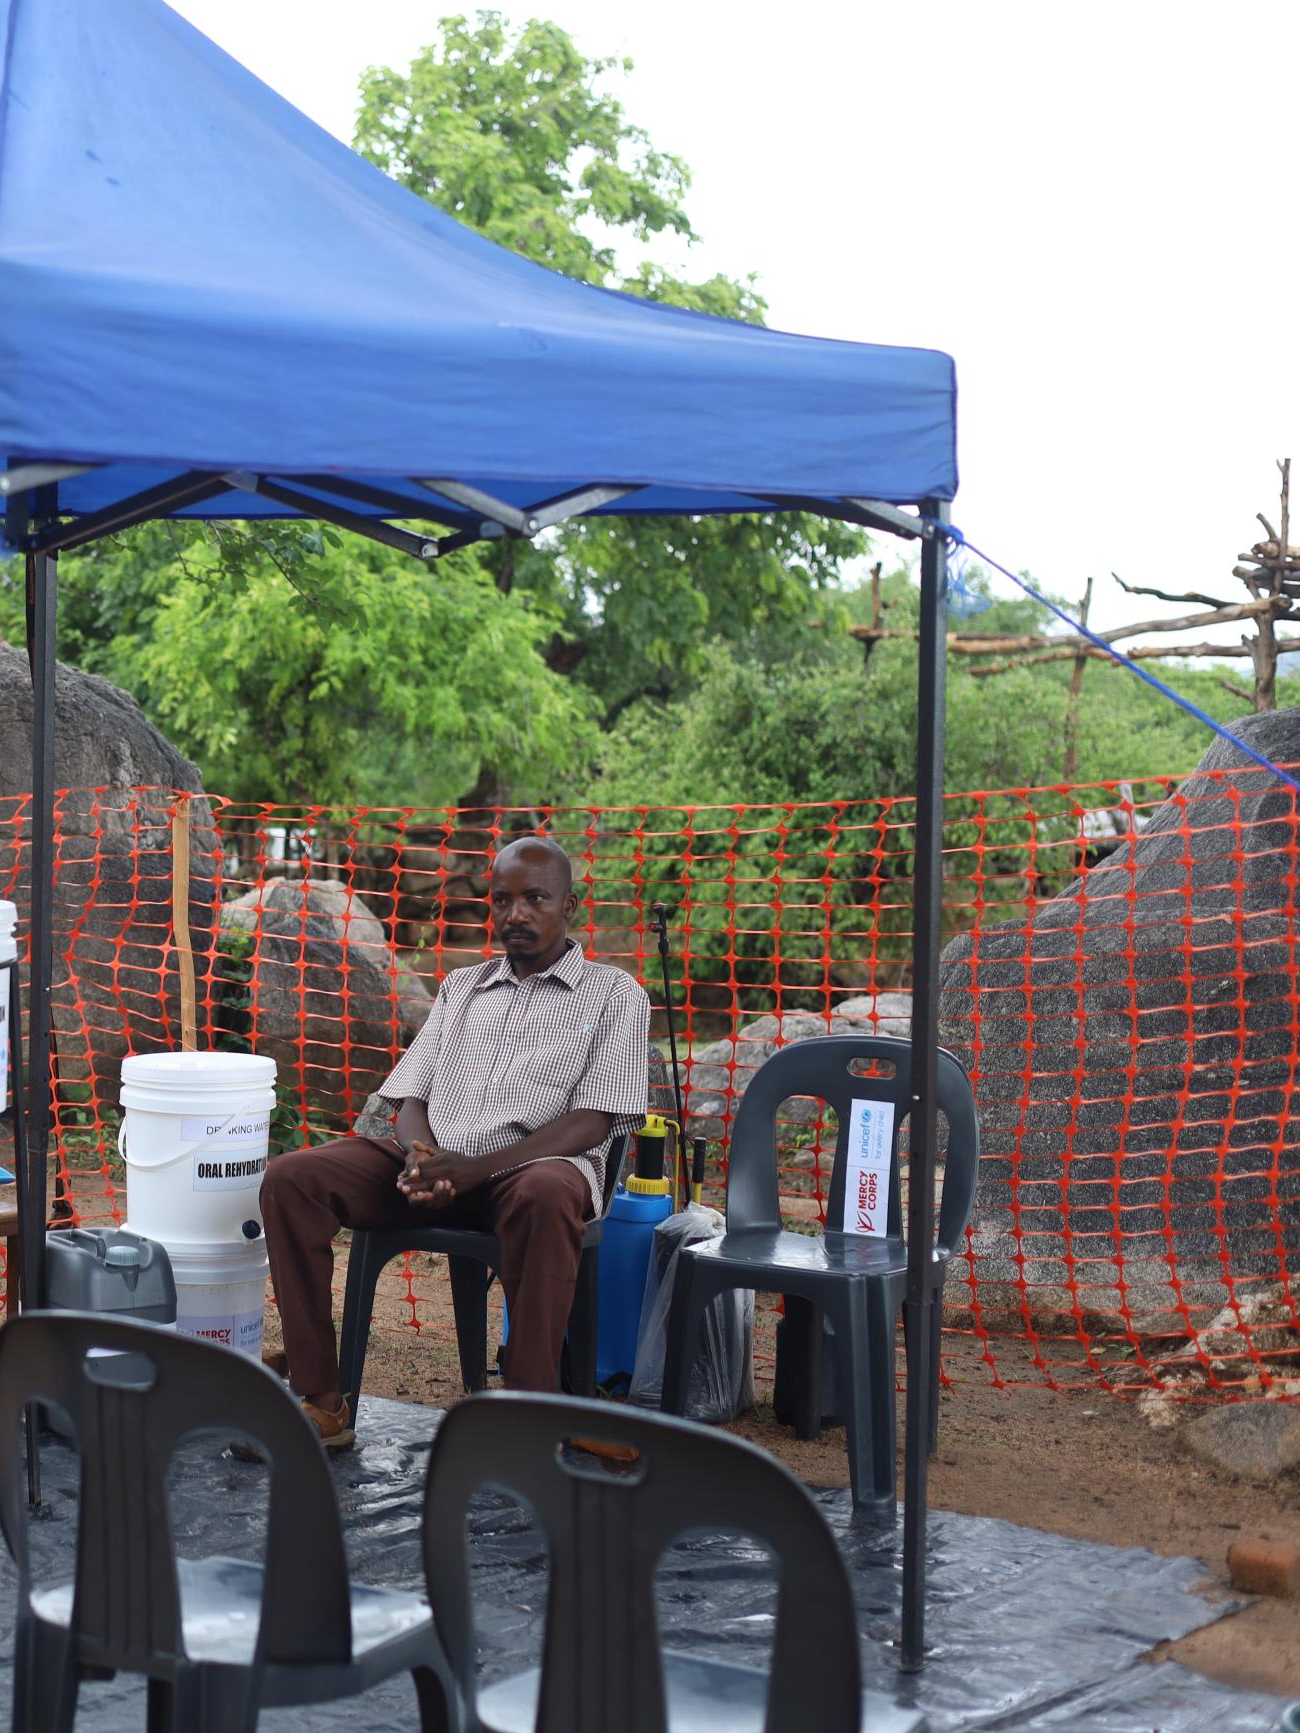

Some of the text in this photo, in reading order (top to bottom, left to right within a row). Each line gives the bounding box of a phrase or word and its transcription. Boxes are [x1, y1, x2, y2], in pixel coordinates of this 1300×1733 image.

[860, 1122, 870, 1158] unicef
[197, 1162, 224, 1179] ORAL
[858, 1170, 868, 1209] MERCY
[868, 1172, 877, 1210] CORPS
[195, 1328, 231, 1339] MERCY
